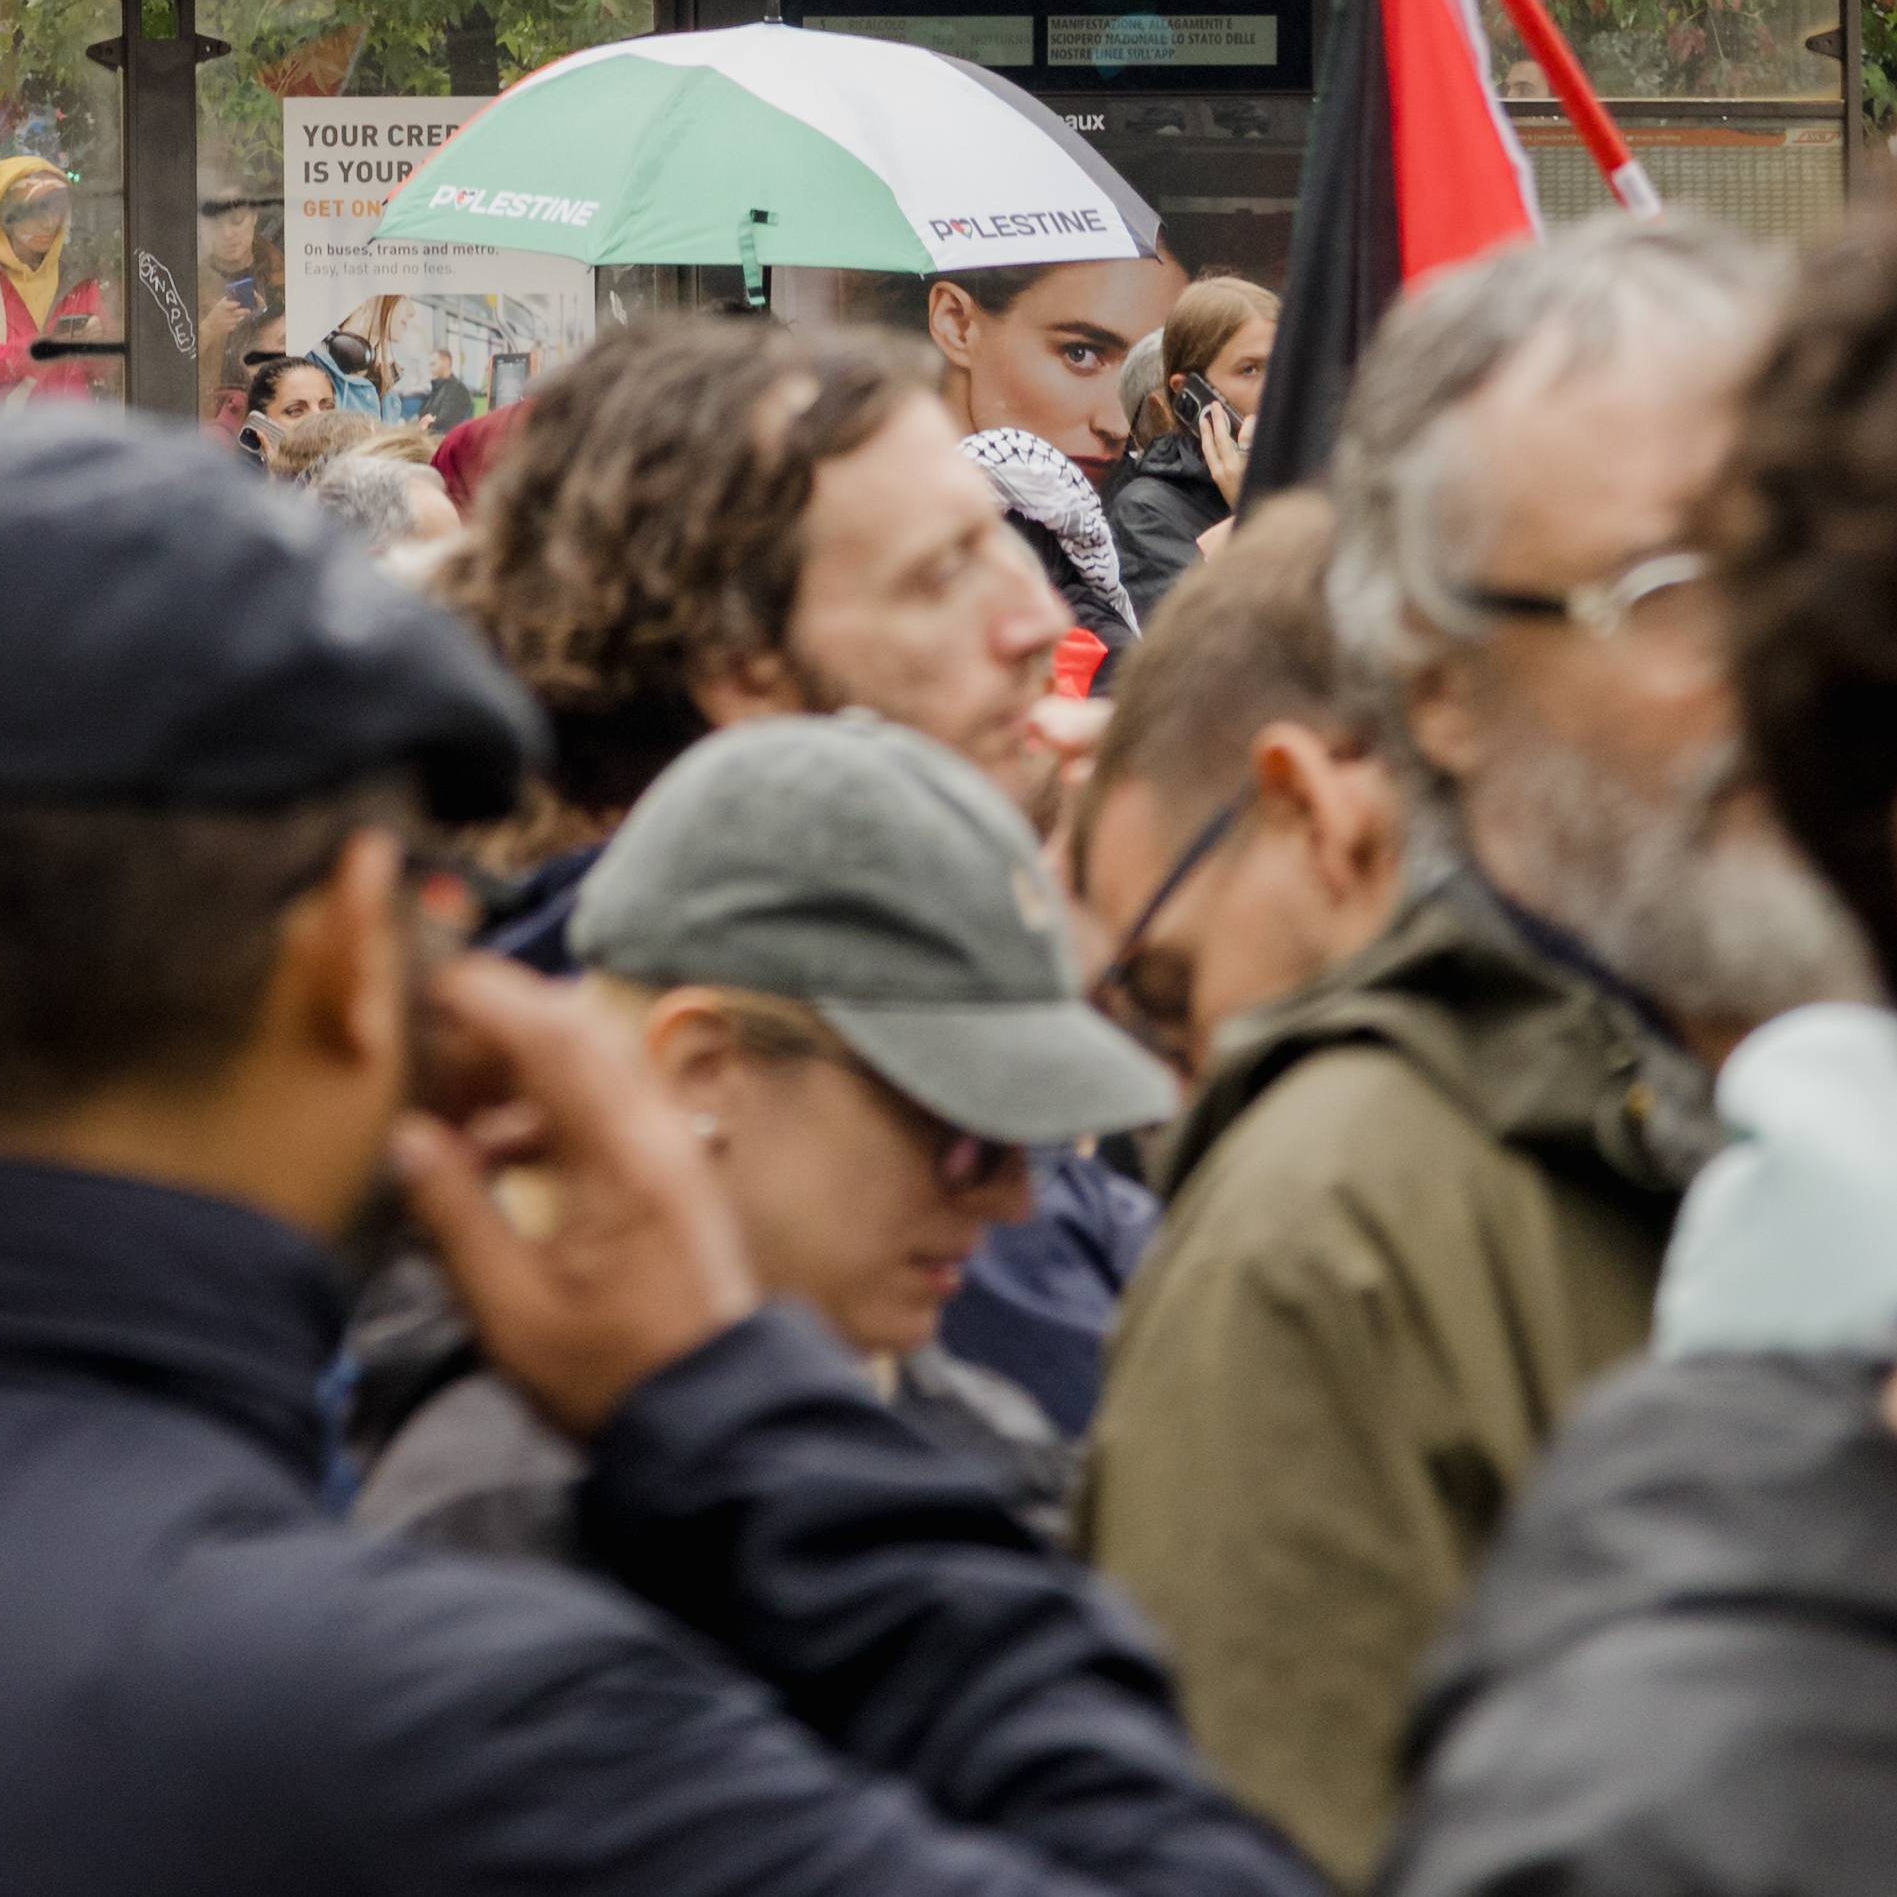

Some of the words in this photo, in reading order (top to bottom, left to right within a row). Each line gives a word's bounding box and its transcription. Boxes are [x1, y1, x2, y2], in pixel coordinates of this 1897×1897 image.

[1050, 33, 1102, 45] SCIOPERO
[1171, 33, 1185, 45] LO
[1188, 33, 1222, 45] STATO
[1226, 33, 1256, 45] DELLE
[1050, 48, 1092, 60] NOSTRE
[1095, 48, 1124, 60] LINEE
[303, 124, 378, 147] YOUR
[304, 161, 329, 183] IS
[338, 160, 413, 183] YOUR
[303, 200, 344, 217] GET
[351, 200, 381, 217] ON
[304, 243, 323, 256] On
[327, 243, 373, 258] buses,
[377, 244, 419, 256] trams
[422, 244, 448, 256] and
[453, 245, 499, 256] metro.
[304, 262, 339, 277] Easy,
[343, 261, 369, 275] fast
[373, 262, 398, 275] and
[402, 264, 419, 275] no
[423, 261, 456, 275] fees.
